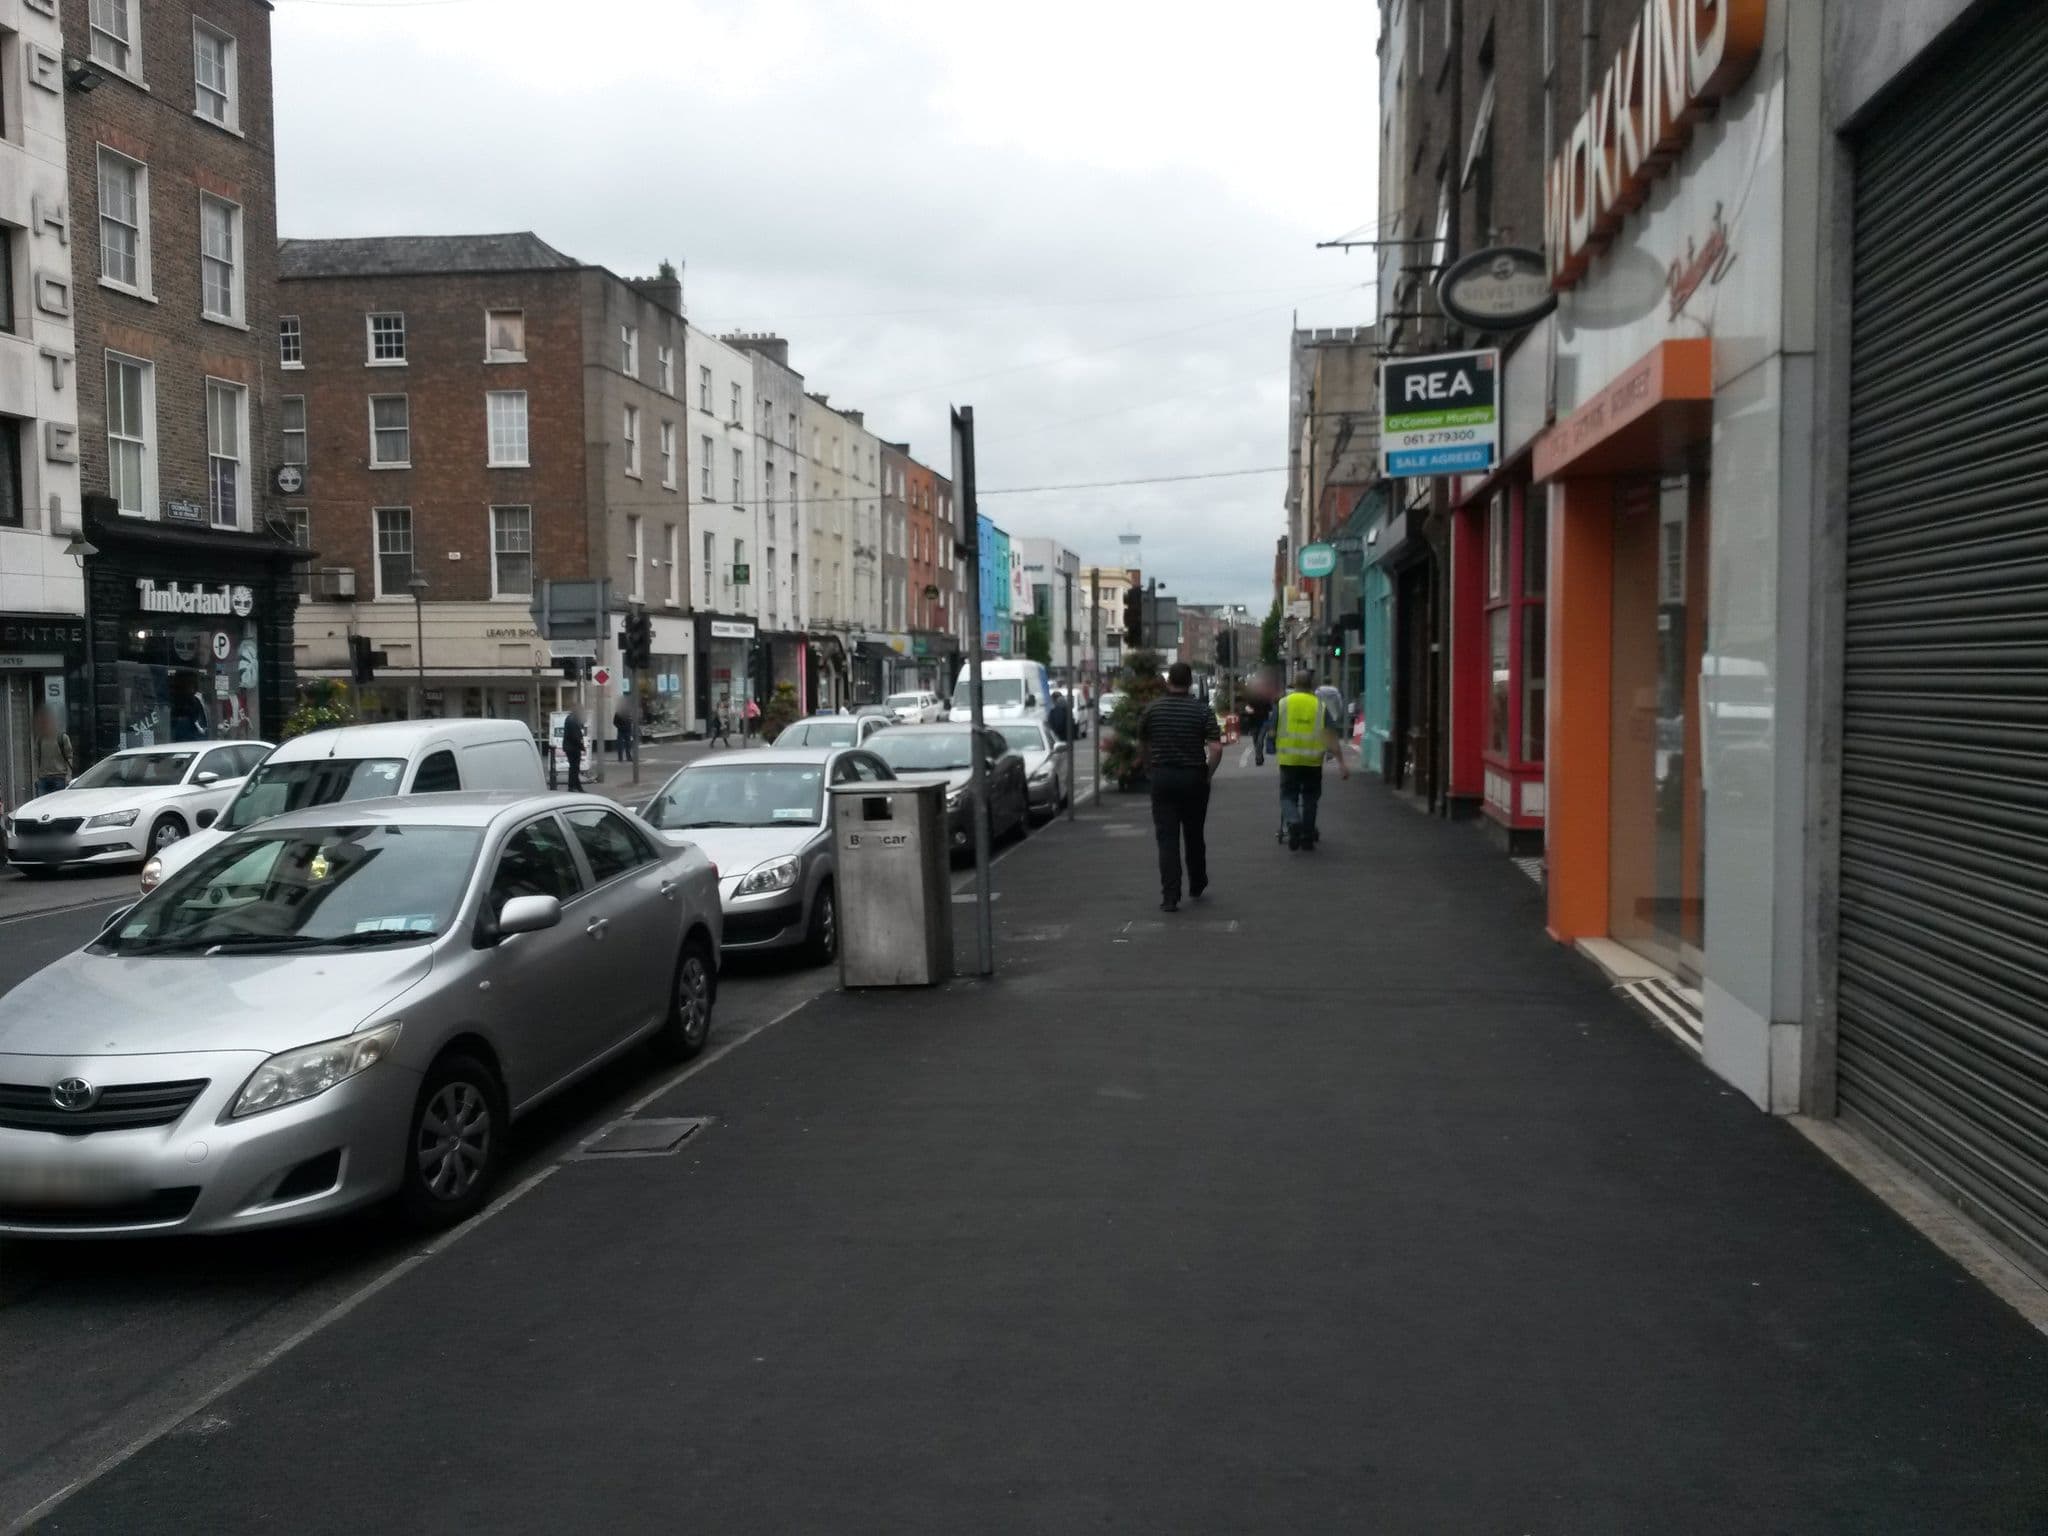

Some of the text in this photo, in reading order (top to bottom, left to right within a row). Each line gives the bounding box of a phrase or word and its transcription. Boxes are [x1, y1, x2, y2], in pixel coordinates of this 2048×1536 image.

[31, 191, 79, 537] HOTEL
[1404, 369, 1474, 402] REA
[1403, 429, 1475, 446] 061 279300
[1395, 448, 1482, 468] SALE AGREED
[135, 578, 232, 614] Timberland
